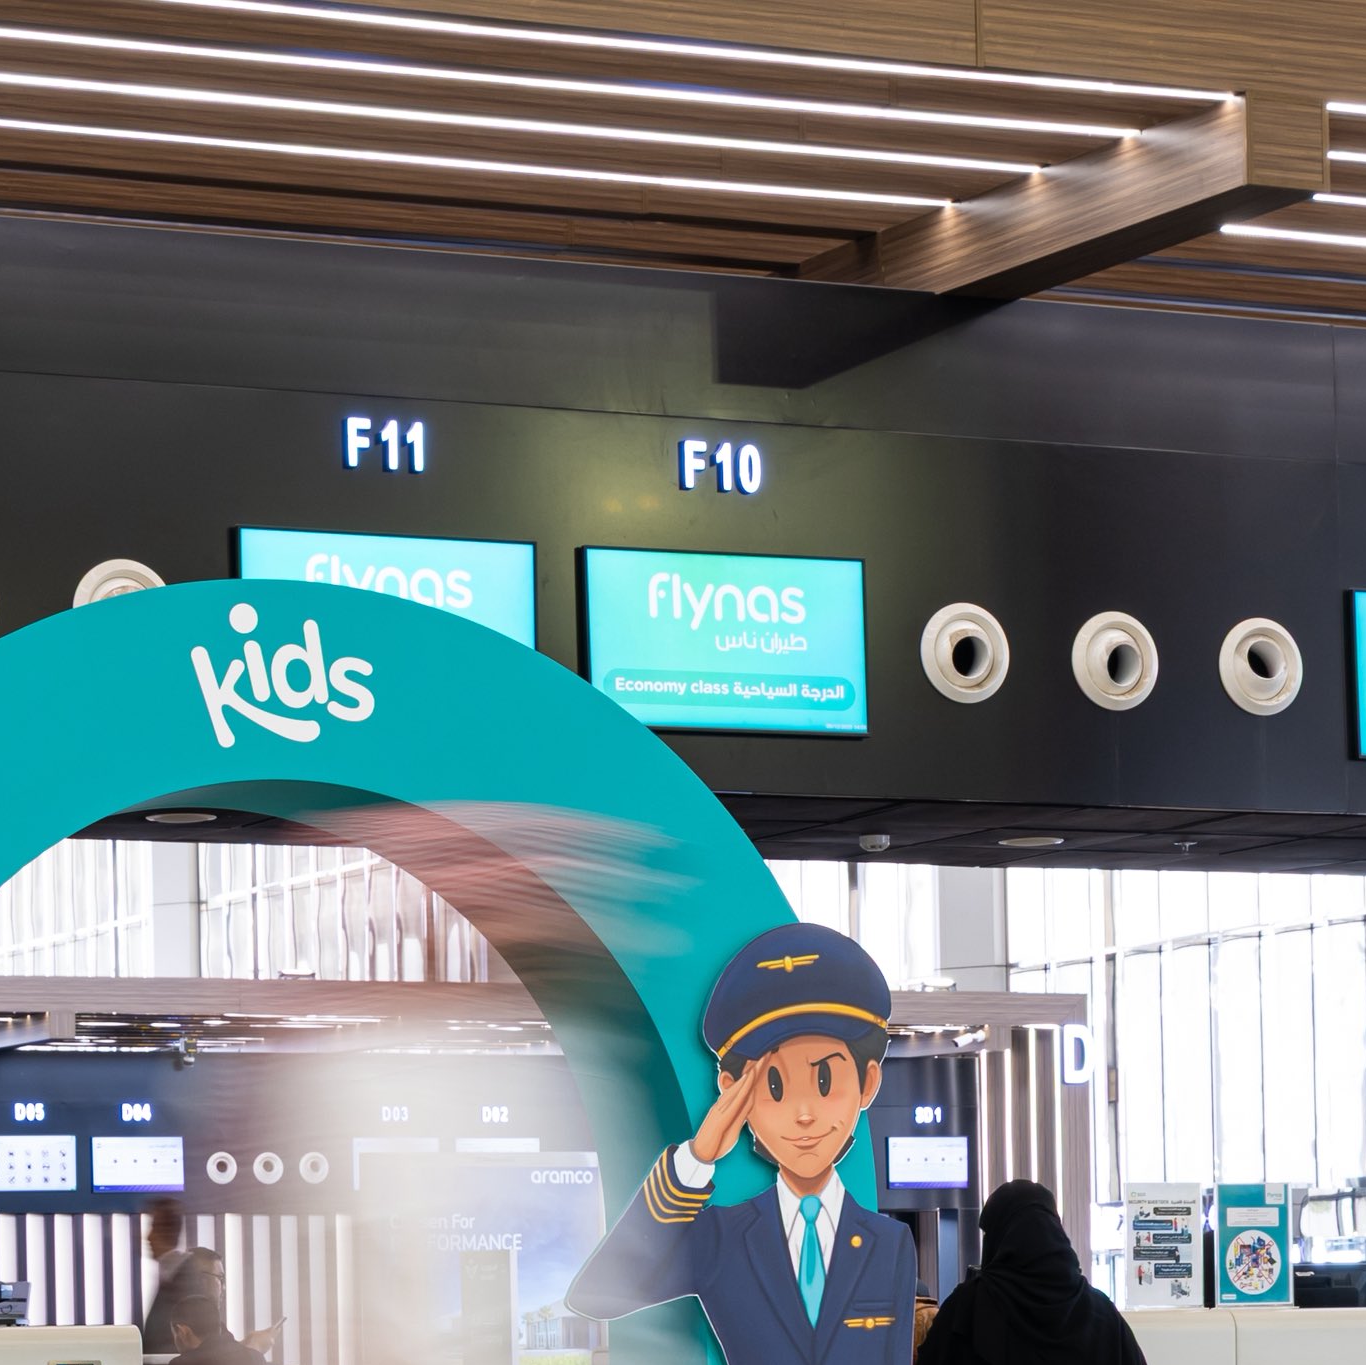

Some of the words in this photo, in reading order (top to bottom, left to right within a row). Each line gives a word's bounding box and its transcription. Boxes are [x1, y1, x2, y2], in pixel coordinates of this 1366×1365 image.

[343, 416, 426, 473] F11
[678, 439, 762, 495] F10
[648, 572, 807, 631] flynas
[715, 630, 757, 651] ناس
[761, 632, 808, 655] طيران
[191, 602, 375, 748] kids
[615, 677, 686, 696] Economy
[690, 679, 729, 695] class
[733, 681, 797, 700] السياحية
[801, 684, 844, 702] الدرجة
[1064, 1024, 1094, 1085] D
[121, 1103, 151, 1122] D04
[382, 1106, 409, 1121] D03
[481, 1106, 509, 1123] D02
[530, 1170, 594, 1184] aramco
